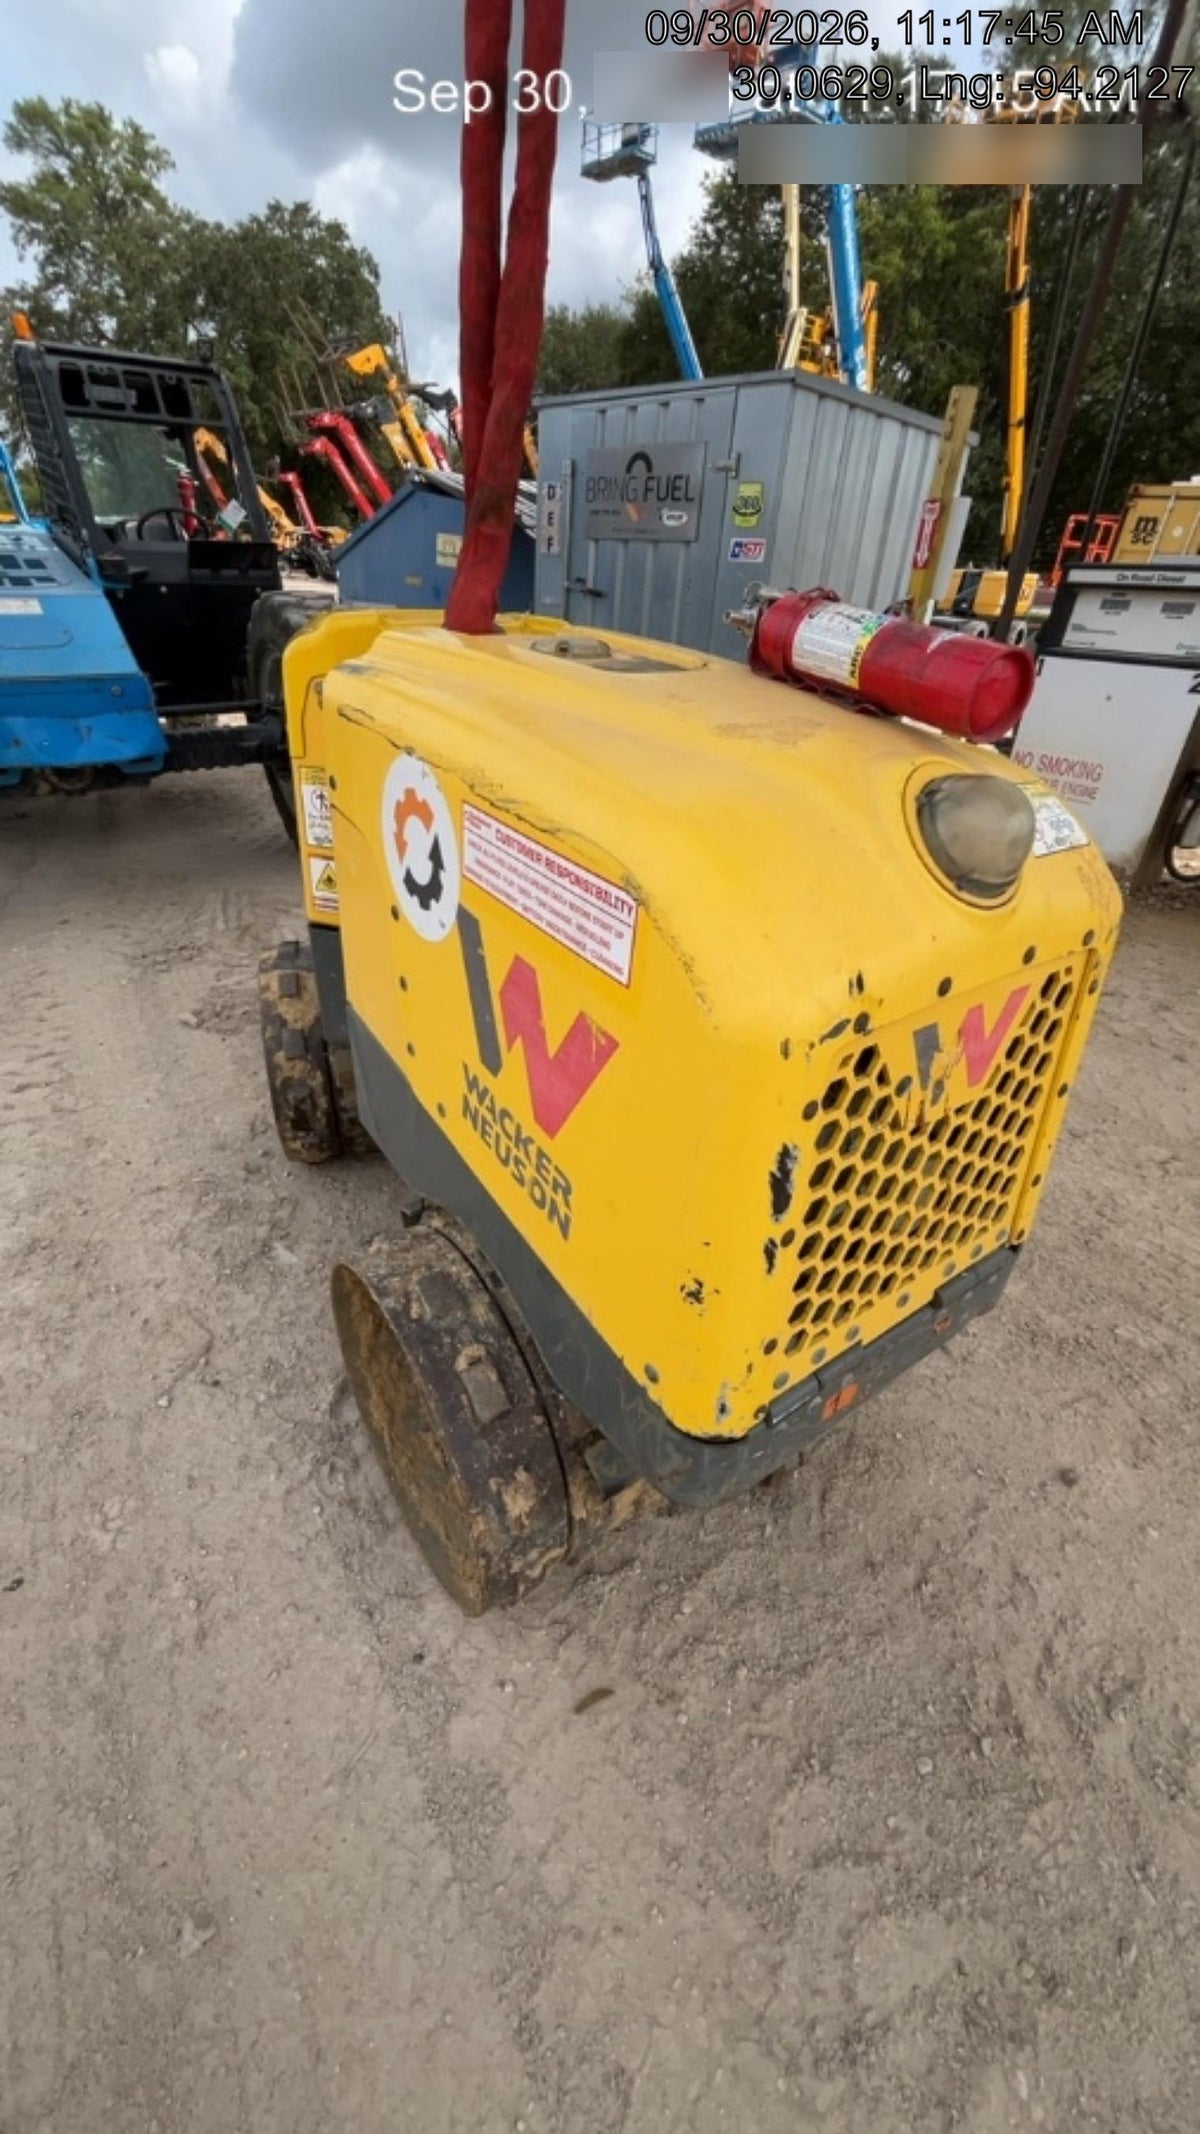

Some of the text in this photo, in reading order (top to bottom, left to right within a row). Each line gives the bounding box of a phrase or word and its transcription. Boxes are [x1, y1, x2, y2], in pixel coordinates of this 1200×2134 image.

[585, 473, 695, 503] BRING FUEL
[1013, 751, 1104, 783] NO SMOKING
[494, 827, 544, 865] CUSTOMER
[544, 856, 635, 918] RESPONSIBILITY
[461, 1092, 573, 1243] NEUSON
[462, 1060, 573, 1212] WACKER
